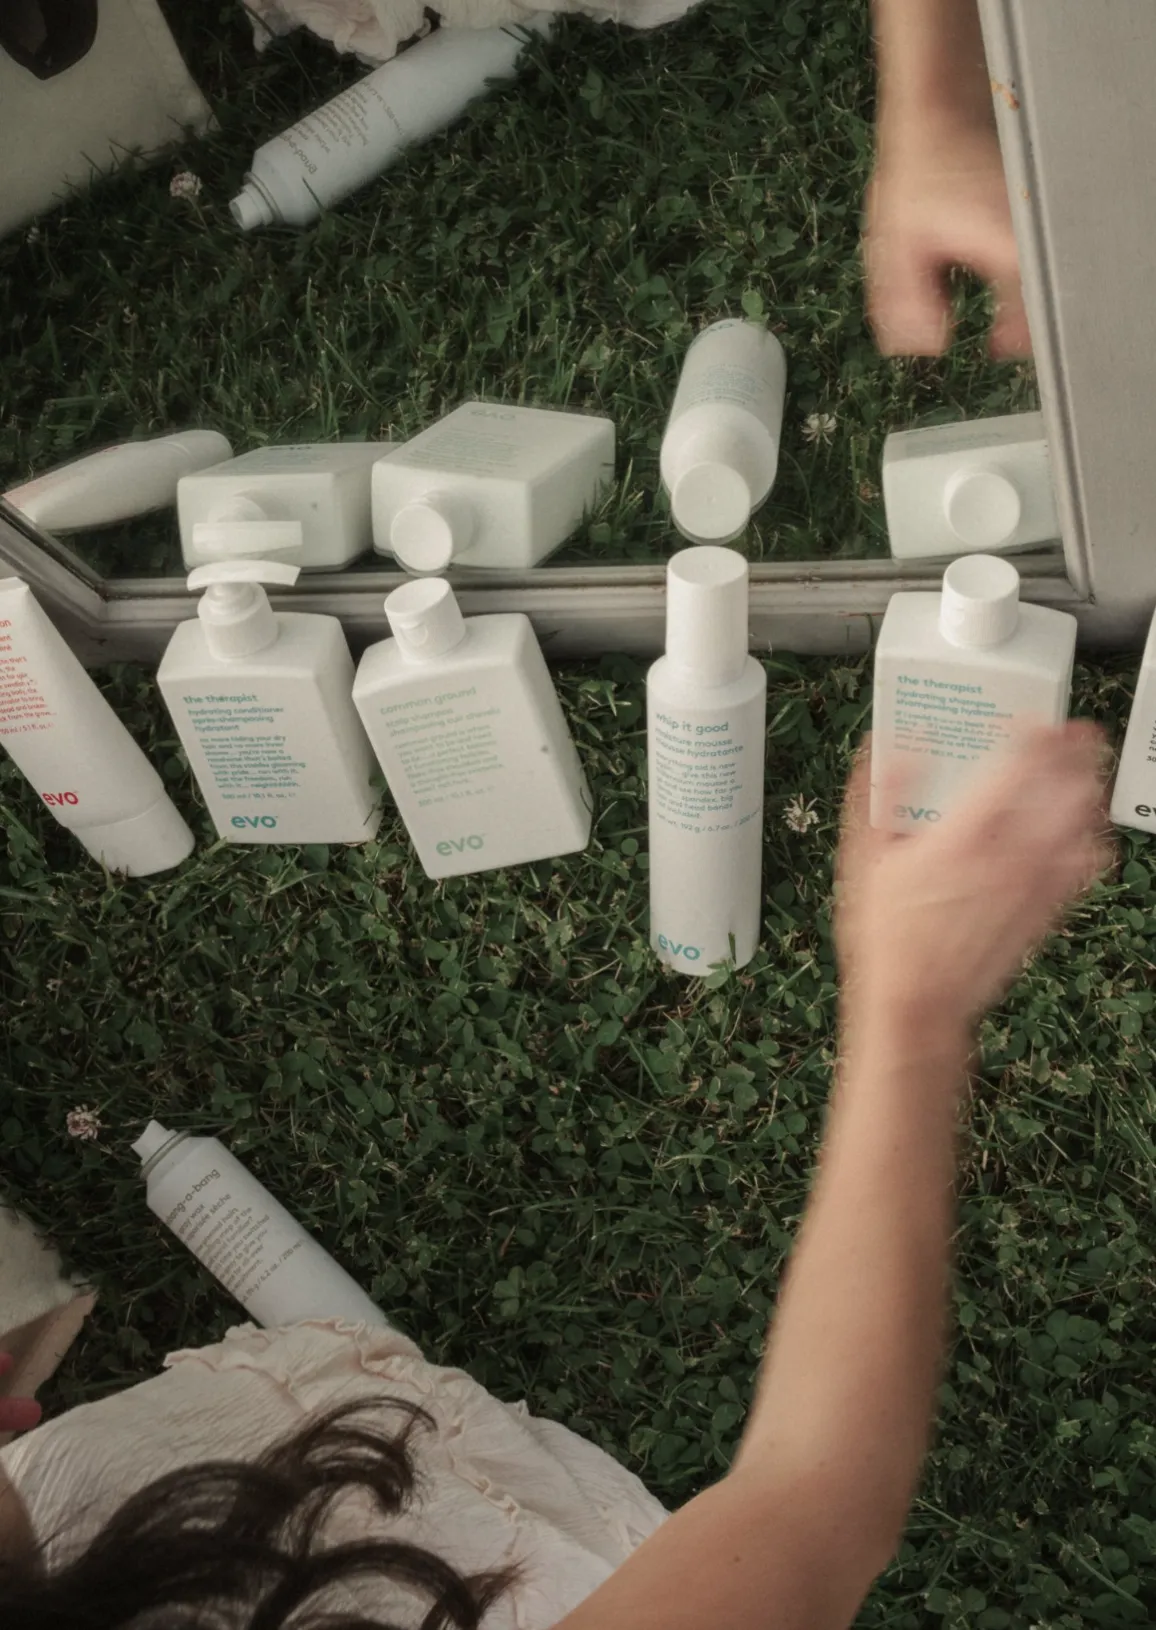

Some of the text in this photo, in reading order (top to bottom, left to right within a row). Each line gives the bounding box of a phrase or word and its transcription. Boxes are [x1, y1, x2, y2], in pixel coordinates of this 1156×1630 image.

[898, 675, 983, 694] the therapist
[183, 694, 258, 704] the therapist
[380, 686, 477, 715] common ground
[895, 689, 996, 709] hydrating shampoo
[188, 708, 232, 716] hydrating
[682, 721, 692, 732] it
[696, 722, 729, 735] good
[694, 739, 732, 747] mousse
[687, 745, 744, 759] hydratante
[42, 791, 79, 806] evo
[231, 816, 276, 828] evo
[436, 835, 484, 857] evo
[658, 933, 701, 960] evo
